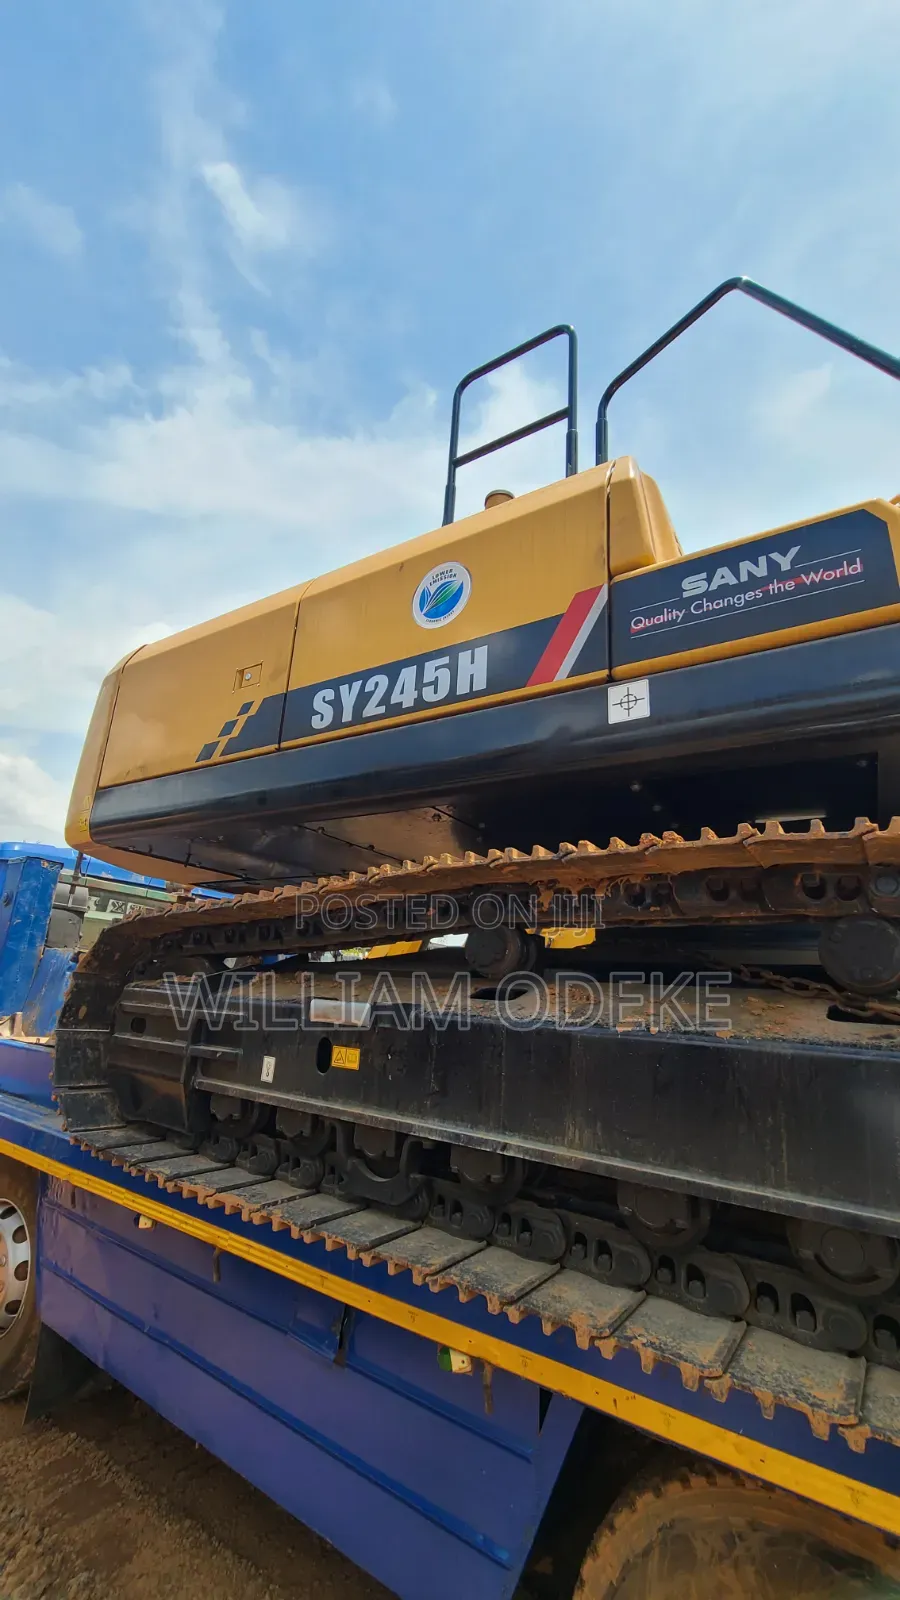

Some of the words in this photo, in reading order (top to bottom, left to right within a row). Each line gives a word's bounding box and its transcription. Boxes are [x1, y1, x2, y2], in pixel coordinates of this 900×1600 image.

[631, 607, 685, 630] Quality
[690, 588, 763, 615] Changes
[769, 578, 796, 596] the
[801, 557, 862, 586] World
[681, 545, 801, 598] SANY
[311, 644, 489, 730] SY245H
